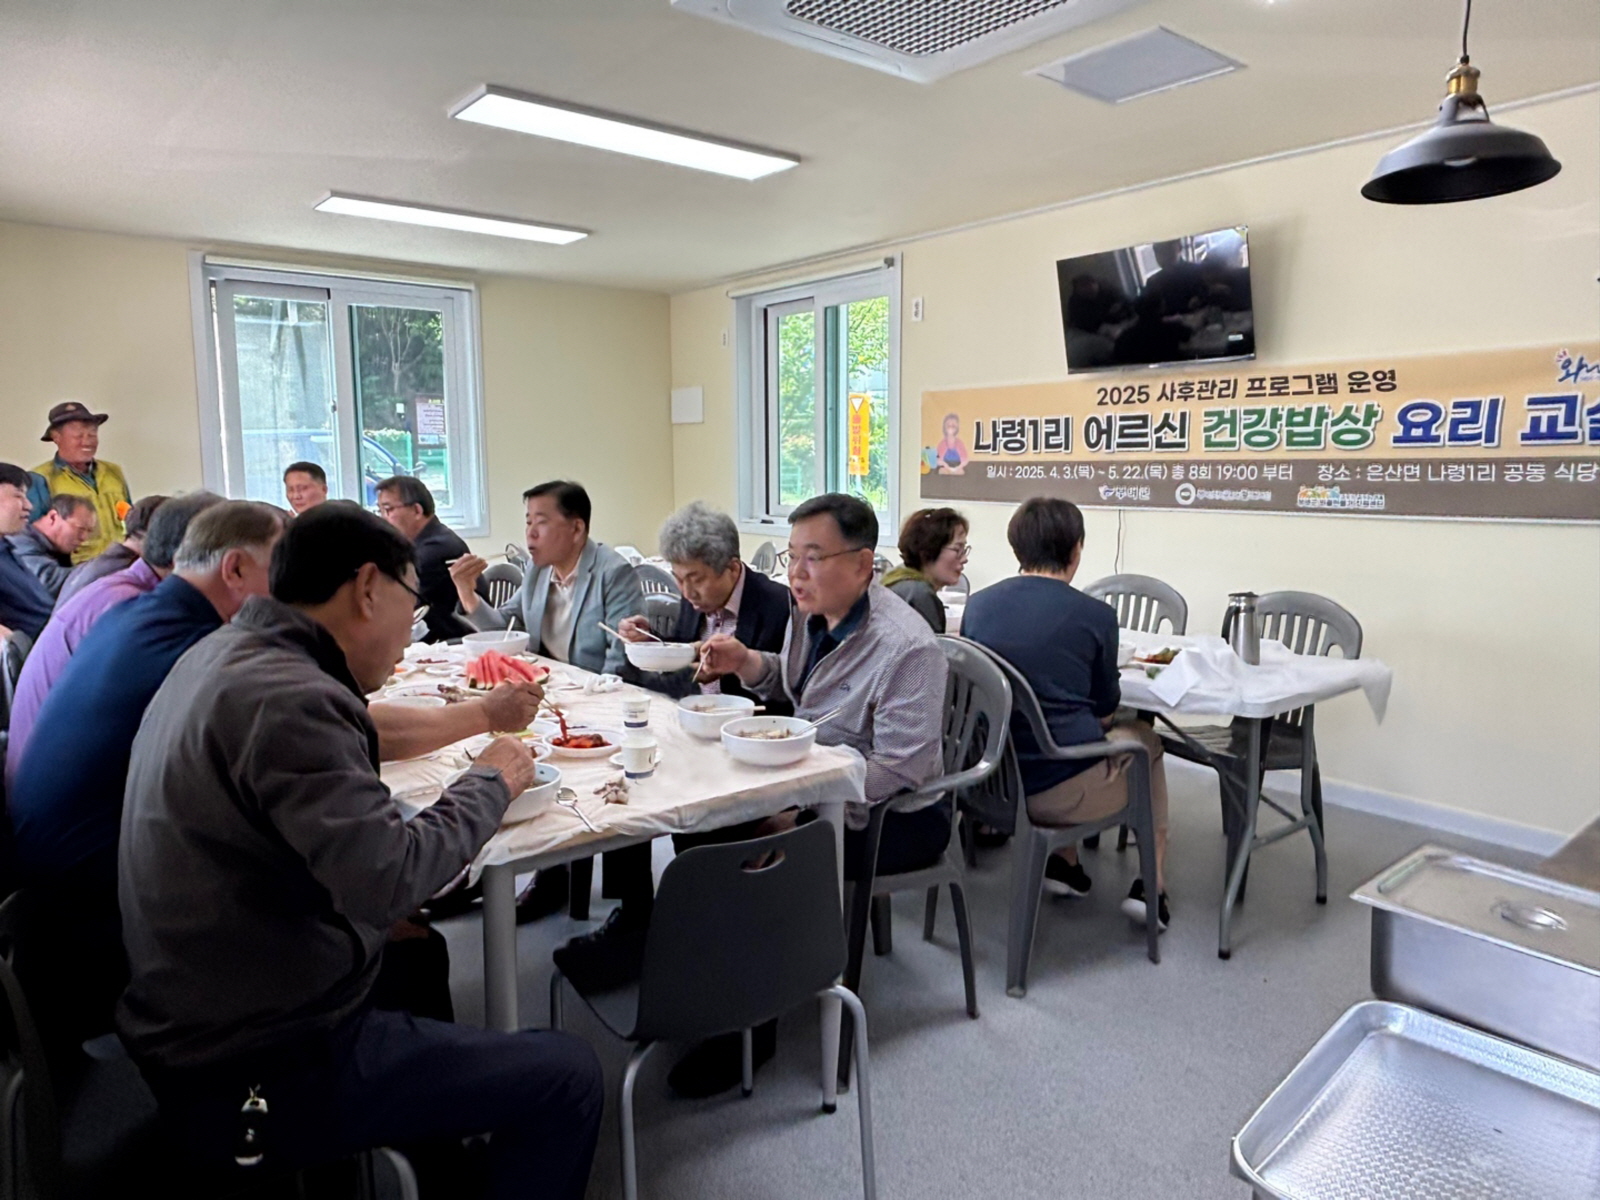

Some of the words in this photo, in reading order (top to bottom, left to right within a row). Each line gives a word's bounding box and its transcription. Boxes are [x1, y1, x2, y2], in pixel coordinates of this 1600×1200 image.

[1096, 385, 1151, 406] 2025
[1156, 377, 1239, 402] 사후관리
[1245, 372, 1339, 398] 프로그램
[1347, 369, 1398, 394] 운영
[973, 415, 1072, 454] 나령1리
[1083, 410, 1189, 451] 어르신
[1202, 402, 1381, 450] 건강밥상
[1391, 397, 1502, 445] 요리
[1172, 463, 1185, 480] 총
[1188, 463, 1212, 480] 8회
[1216, 464, 1259, 480] 19:00
[1262, 463, 1294, 481] 부터
[1317, 463, 1351, 481] 장소
[1366, 463, 1421, 482] 은산면
[1427, 463, 1496, 482] 나령1리
[1503, 462, 1547, 482] 공동
[1554, 462, 1600, 482] 식당
